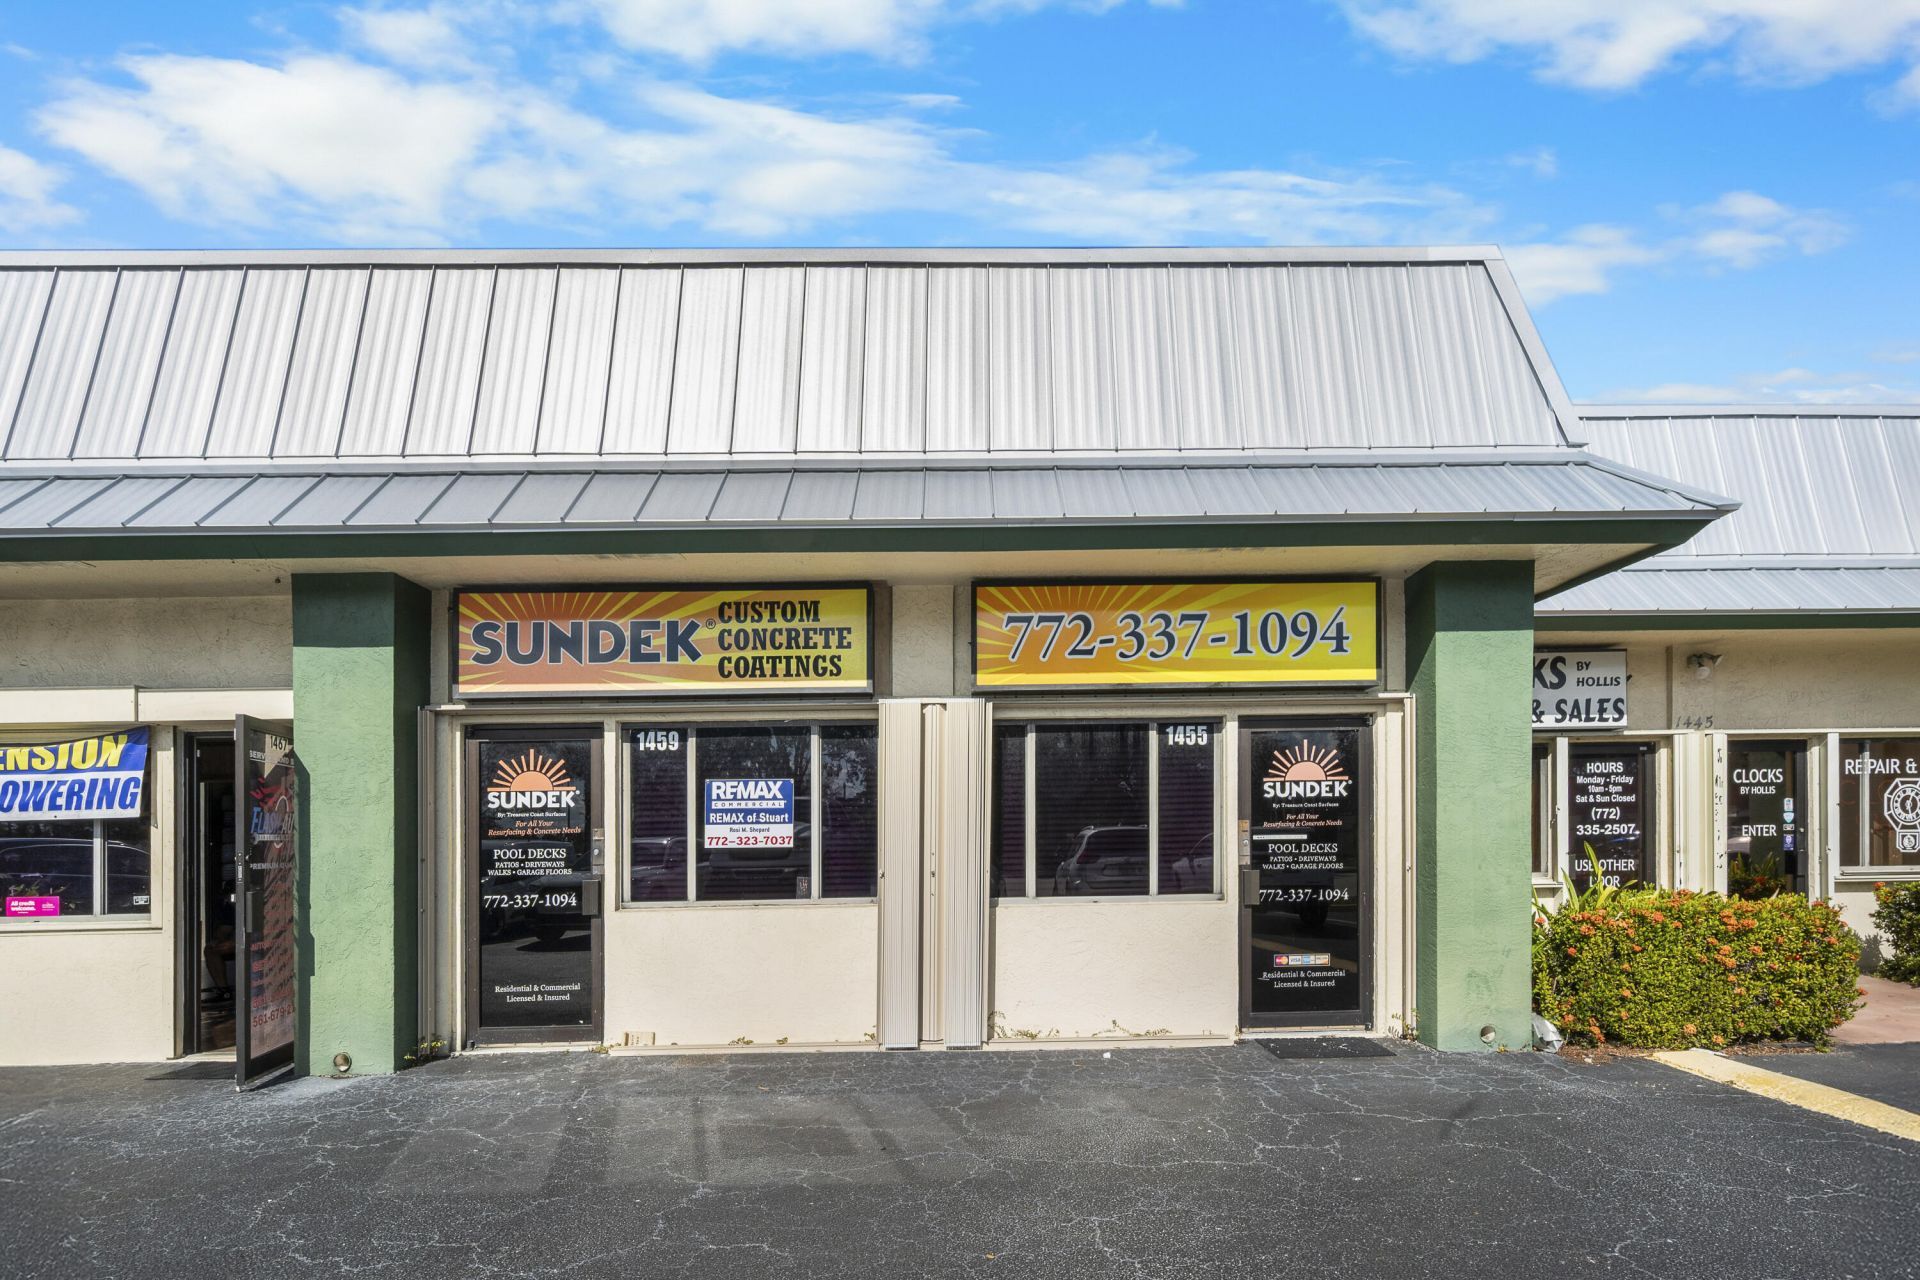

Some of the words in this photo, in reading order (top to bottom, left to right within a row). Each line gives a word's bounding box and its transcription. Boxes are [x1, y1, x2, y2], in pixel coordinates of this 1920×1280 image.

[718, 600, 821, 625] CUSTOM
[718, 627, 852, 651] CONCRETE
[1001, 604, 1352, 662] 772-337-1094
[718, 655, 842, 679] COATINGS
[1576, 661, 1592, 671] BY
[1576, 676, 1621, 687] HOLLIS
[1554, 698, 1624, 724] SALES
[1676, 716, 1713, 729] 1445
[636, 731, 679, 751] 1459
[1166, 726, 1208, 745] 1455
[270, 736, 288, 751] 1467
[1586, 762, 1624, 774] HOURS
[1845, 758, 1900, 774] REPAIR
[1906, 758, 1918, 774] &
[1576, 776, 1605, 784] Monday
[1610, 775, 1634, 784] Friday
[1733, 768, 1784, 784] CLOCKS
[0, 777, 141, 813] OWERING
[1263, 781, 1348, 798] SUNDEK
[1588, 785, 1604, 793] 10am
[1608, 785, 1622, 794] 5pm
[1740, 786, 1750, 794] BY
[1751, 786, 1776, 794] HOLLIS
[488, 791, 576, 808] SUNDEK
[1576, 794, 1588, 802] Sat
[1588, 794, 1595, 802] &
[1596, 794, 1610, 802] Sun
[1611, 794, 1636, 802] Closed
[710, 812, 744, 823] REMAX
[747, 812, 757, 822] of
[760, 812, 788, 822] Stuart
[1591, 806, 1620, 820] (772)
[488, 828, 526, 837] Resurfacing
[1576, 824, 1636, 836] 335-2507
[1742, 824, 1778, 836] ENTER
[707, 836, 792, 846] 772-323-7037
[494, 849, 526, 860] POOL
[528, 848, 567, 859] DECKS
[1268, 844, 1298, 853] POOL
[1301, 843, 1338, 852] DECKS
[1598, 859, 1635, 871] OTHER
[484, 892, 577, 908] 772-337-1094
[1259, 888, 1350, 902] 772-337-1094
[1262, 970, 1298, 978] Residential
[1306, 970, 1346, 978] Commercial
[540, 983, 580, 991] Commercial
[506, 994, 536, 1002] Licensed
[544, 993, 570, 1001] Insured
